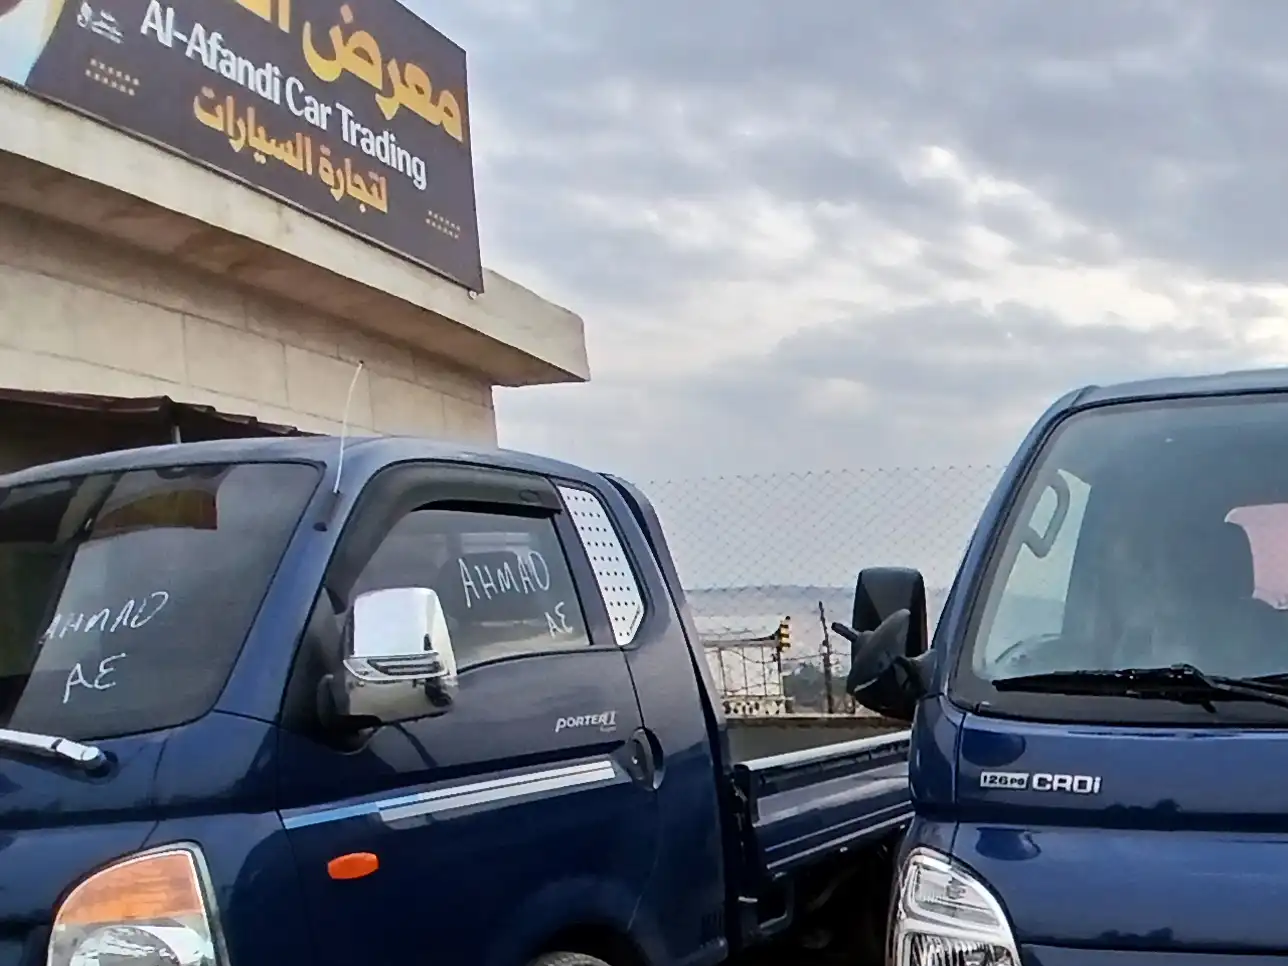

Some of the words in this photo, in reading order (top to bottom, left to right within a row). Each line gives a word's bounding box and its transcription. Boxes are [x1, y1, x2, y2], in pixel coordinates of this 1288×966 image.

[140, 0, 282, 105] Al-Afandi
[286, 76, 332, 131] Car
[335, 102, 427, 190] Trading
[302, 4, 463, 142] معرض
[193, 86, 312, 175] السيارات
[318, 144, 388, 214] لتجارة
[63, 653, 126, 703] AE
